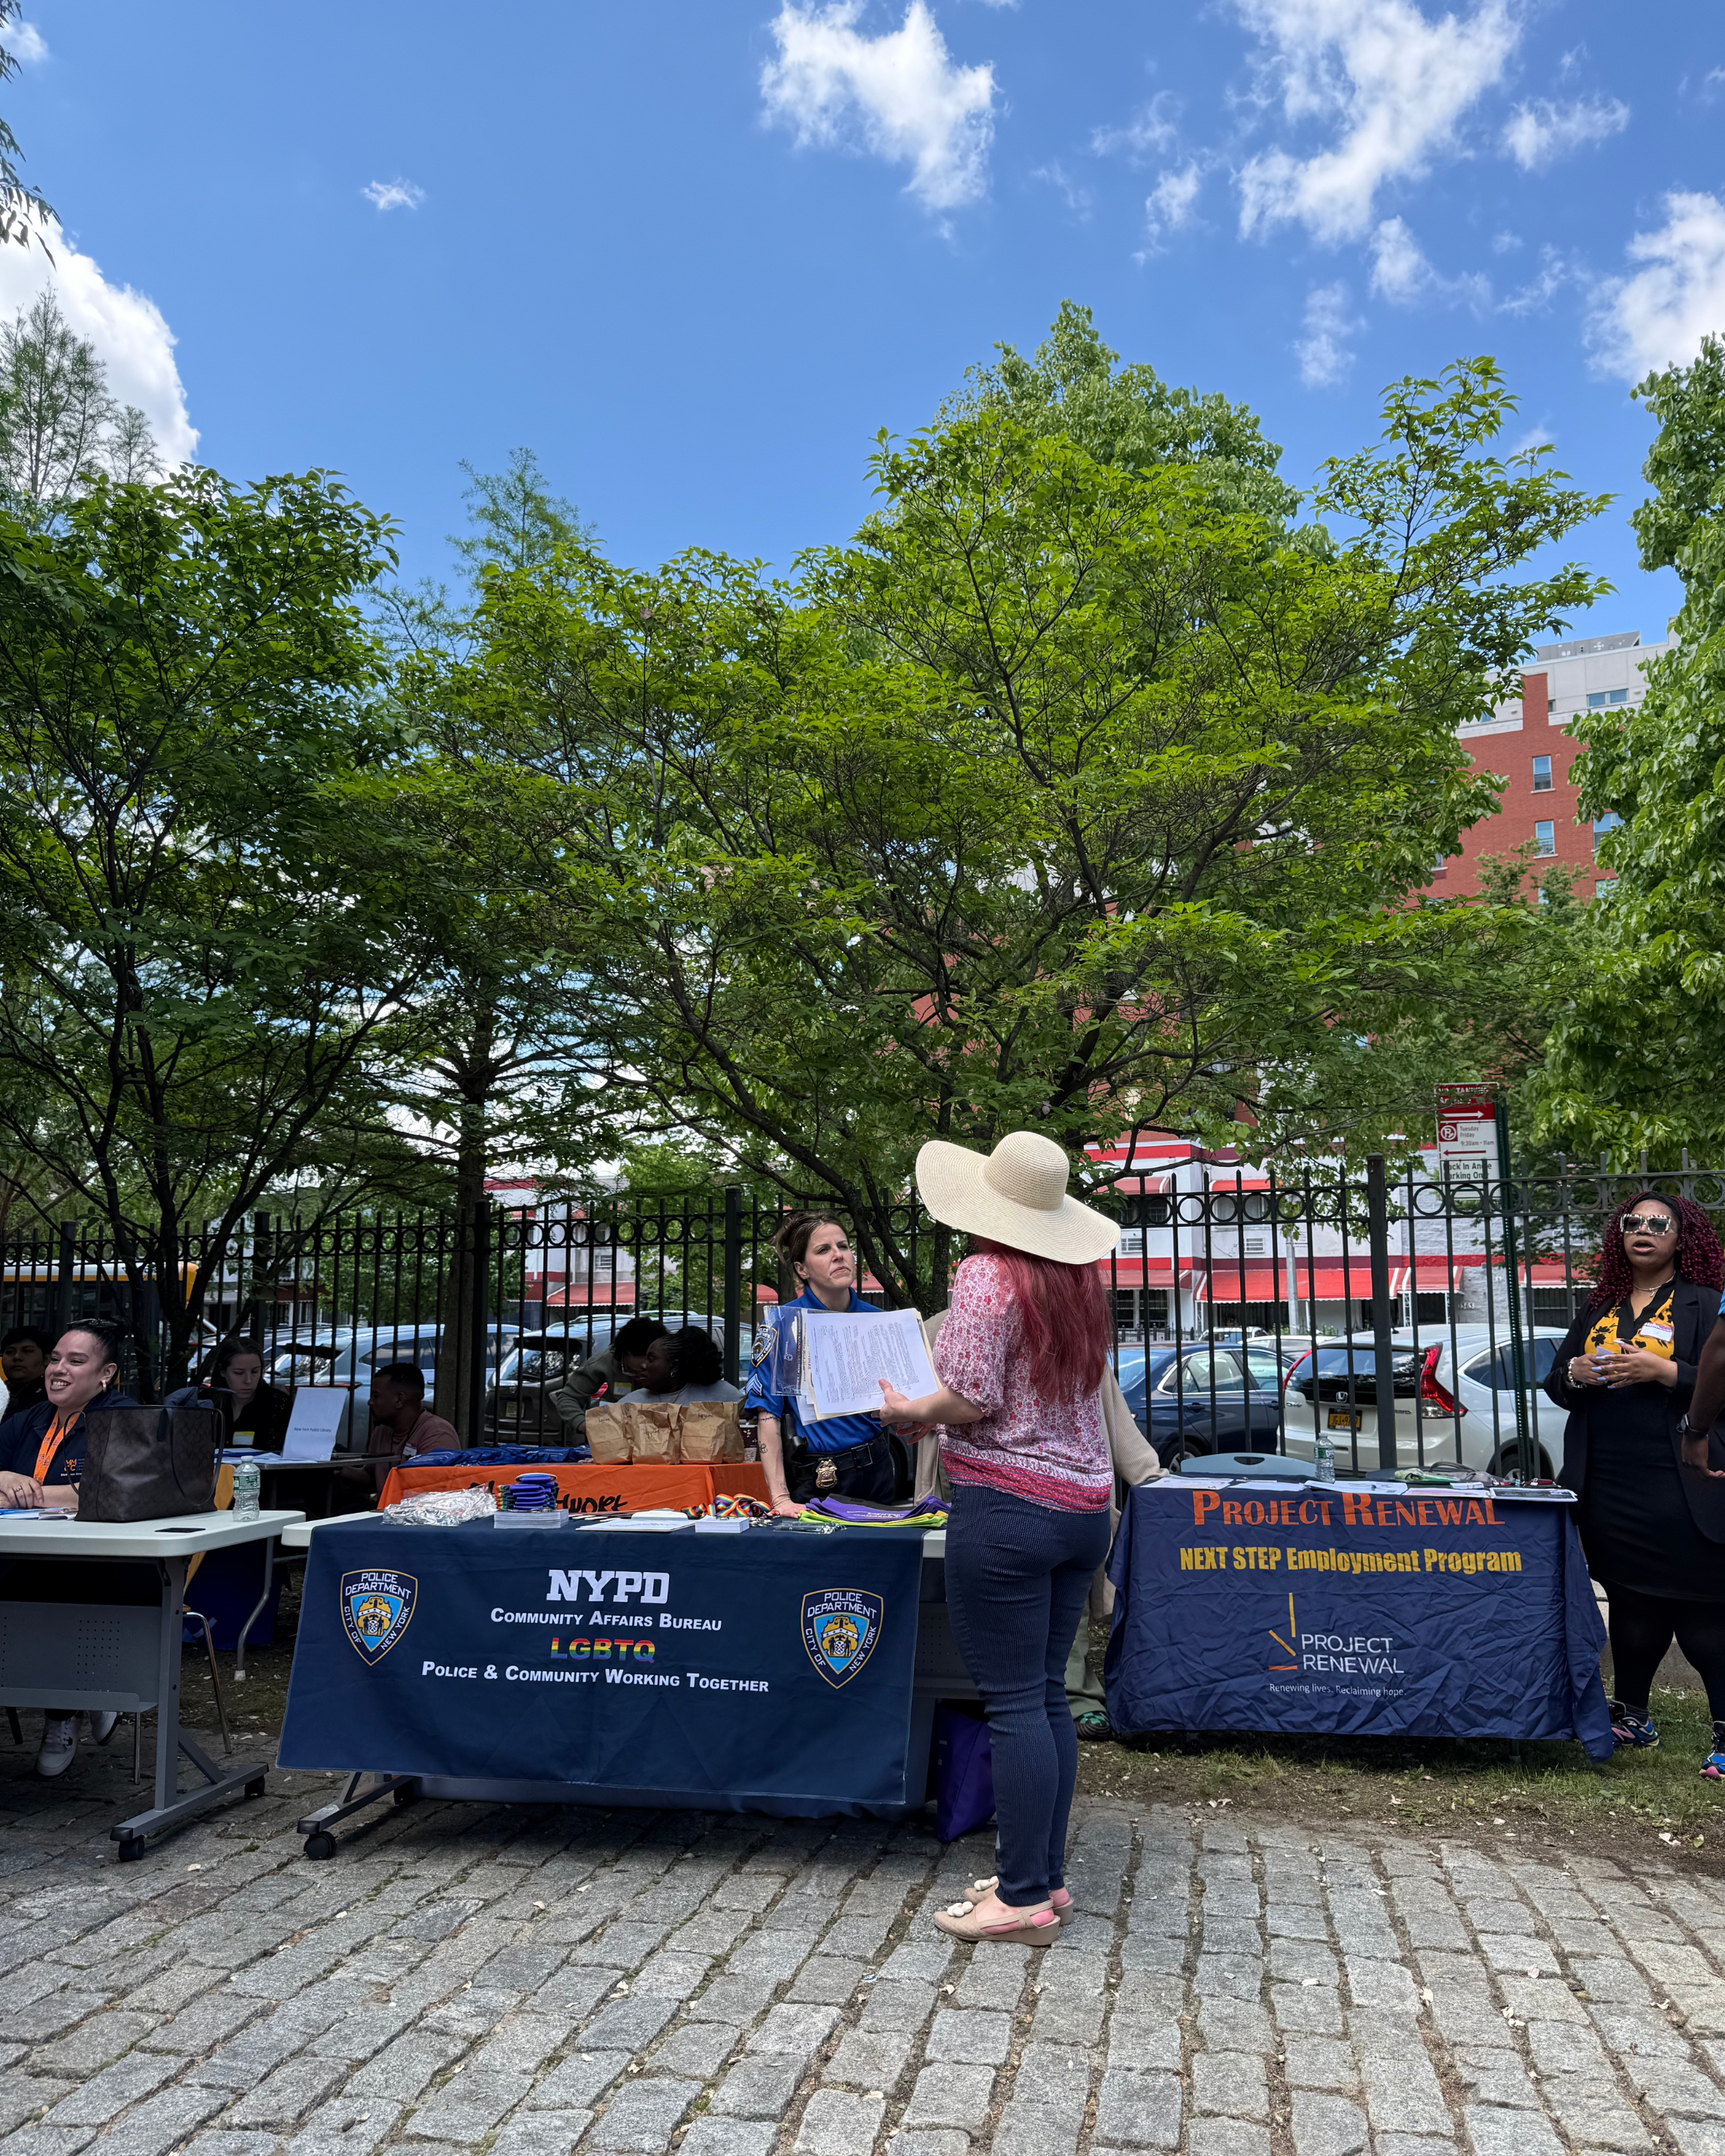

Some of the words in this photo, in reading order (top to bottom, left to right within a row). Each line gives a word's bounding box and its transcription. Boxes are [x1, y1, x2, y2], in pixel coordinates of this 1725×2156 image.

[1445, 1172, 1471, 1181] arking
[1473, 1172, 1489, 1180] On
[1192, 1490, 1333, 1526] PROJECT
[1342, 1492, 1506, 1526] RENEWAL
[1180, 1547, 1228, 1571] NEXT
[1233, 1546, 1282, 1570] STEP
[1286, 1547, 1421, 1575] Employment
[1424, 1548, 1522, 1575] Program
[361, 1572, 398, 1584] POLICE
[546, 1569, 670, 1604] NYPD
[345, 1582, 412, 1600] DEPARTMENT
[824, 1592, 862, 1603] POLICE
[490, 1607, 583, 1625] COMMUNITY
[589, 1610, 653, 1627] AFFAIRS
[659, 1613, 722, 1631] BUREAU
[807, 1601, 877, 1619] DEPARTMENT
[343, 1606, 355, 1628] CITY
[351, 1631, 362, 1643] OF
[380, 1631, 397, 1650] NEW
[395, 1606, 410, 1628] YORK
[550, 1637, 655, 1664] LGBTQ
[805, 1628, 818, 1651] CITY
[814, 1653, 826, 1666] OF
[849, 1651, 866, 1672] NEW
[863, 1626, 877, 1650] YORK
[1301, 1634, 1393, 1653] PROJECT
[422, 1661, 477, 1679] POLICE
[483, 1664, 498, 1680] &
[505, 1665, 599, 1683] COMMUNITY
[604, 1668, 680, 1686] WORKING
[686, 1673, 769, 1692] TOGETHER
[1303, 1654, 1404, 1674] RENEWAL
[1270, 1683, 1309, 1694] Renewing
[1312, 1683, 1333, 1693] lives.
[1336, 1685, 1382, 1696] Reclaiming
[1383, 1687, 1407, 1698] hope.
